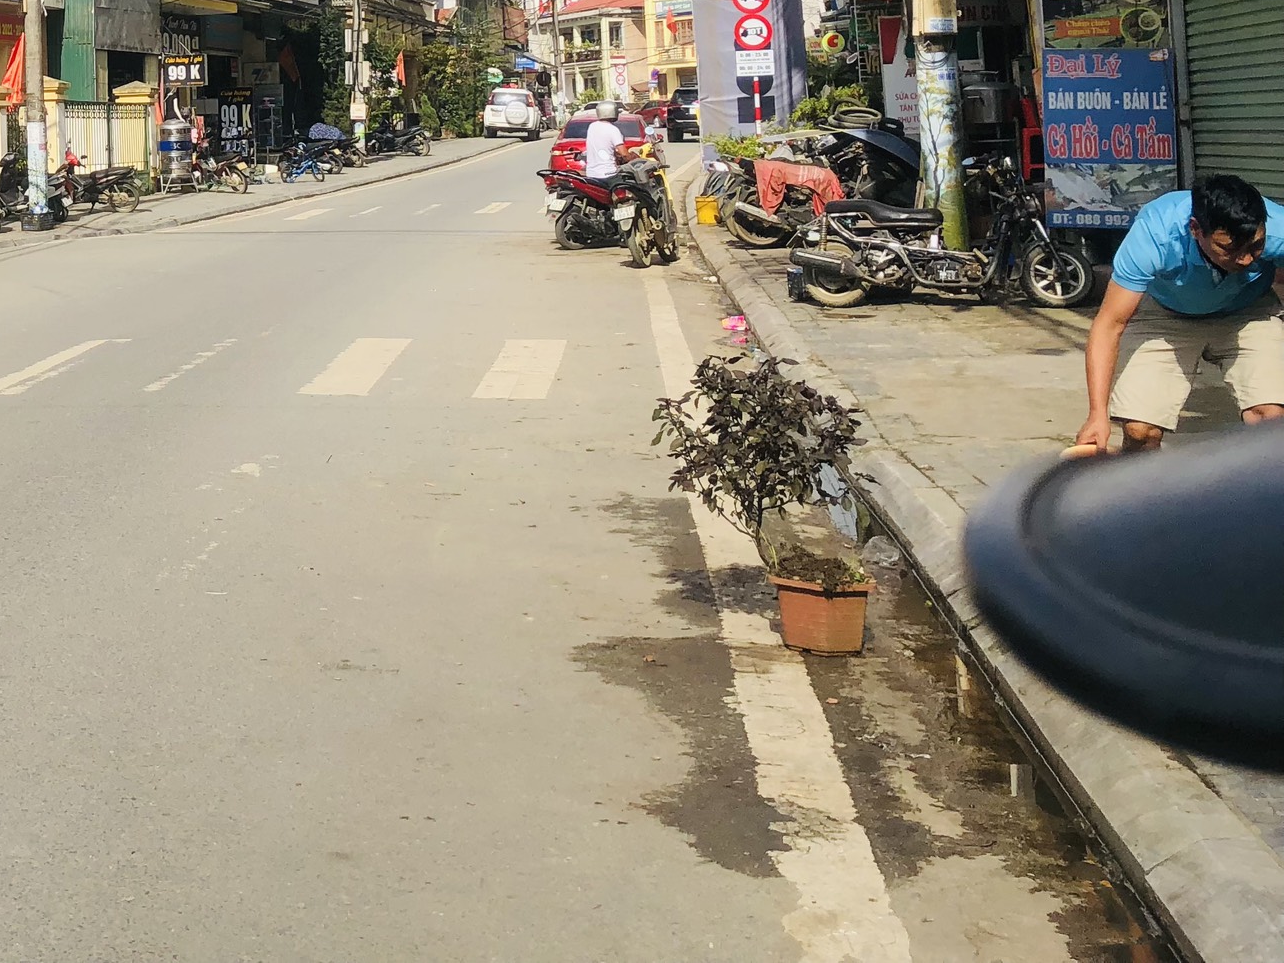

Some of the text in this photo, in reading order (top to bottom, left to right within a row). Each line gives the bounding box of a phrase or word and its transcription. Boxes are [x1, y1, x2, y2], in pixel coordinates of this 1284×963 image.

[168, 64, 201, 81] 99 K
[1046, 52, 1122, 79] Đại Lý
[1048, 88, 1074, 110] BÁN
[1076, 88, 1112, 111] BUÔN
[1123, 87, 1150, 111] BÁN
[1152, 85, 1168, 110] LẺ
[220, 103, 252, 129] 99 K
[1047, 122, 1068, 159] Cá
[1070, 115, 1100, 159] Hồi
[1111, 122, 1133, 160] Cá
[1135, 115, 1173, 160] Tầm
